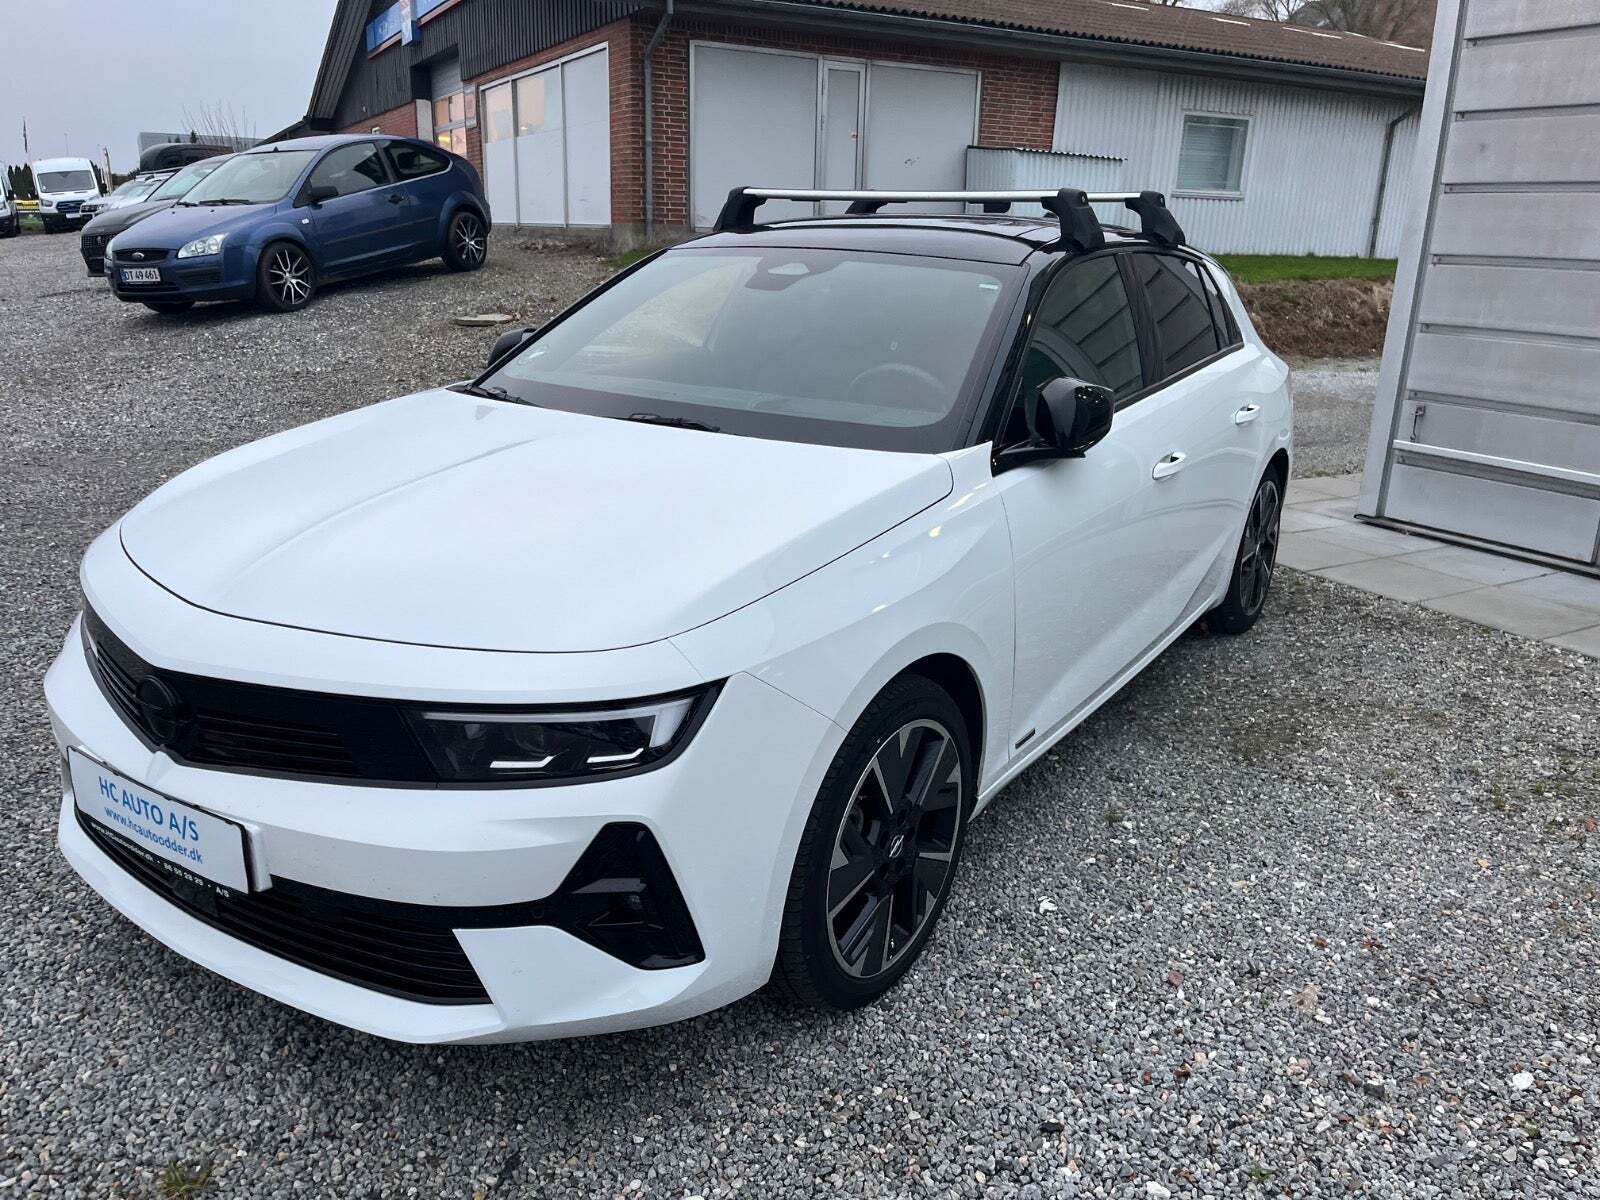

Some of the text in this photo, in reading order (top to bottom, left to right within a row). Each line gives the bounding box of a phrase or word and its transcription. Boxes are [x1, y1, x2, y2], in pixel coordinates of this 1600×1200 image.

[135, 270, 144, 280] 49
[145, 269, 158, 279] 461
[98, 775, 199, 841] HC AUTO A/S
[104, 806, 203, 864] www.hcautoodder.dk
